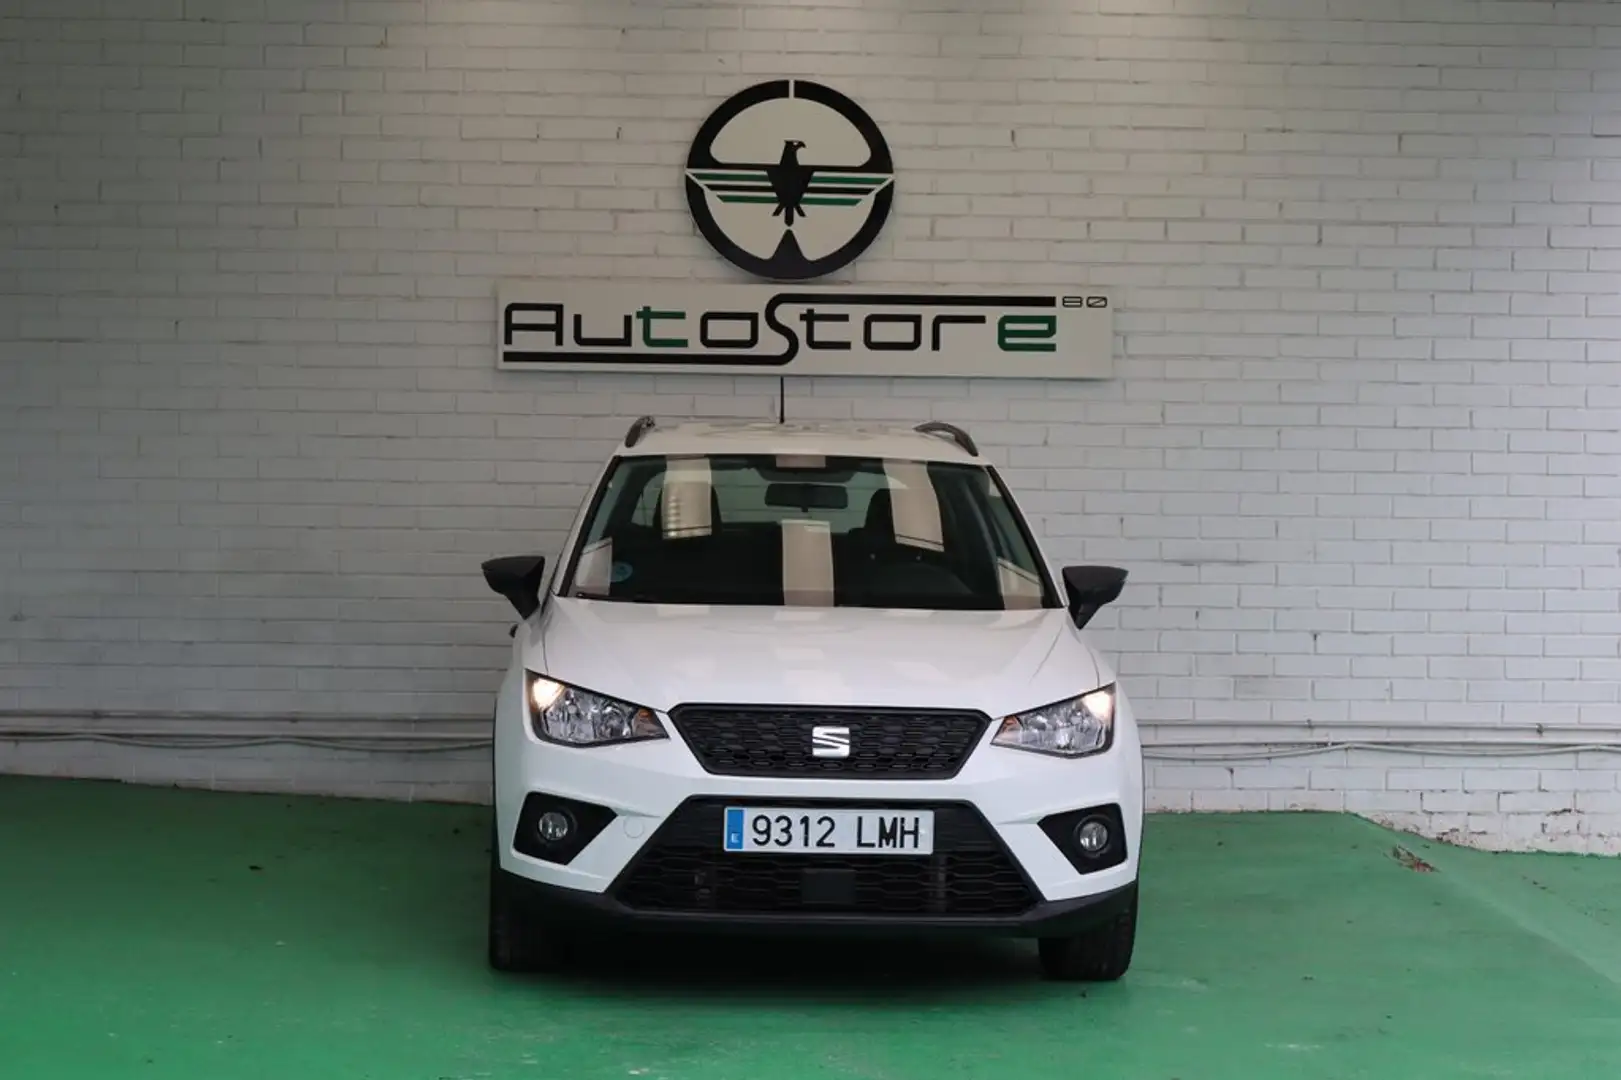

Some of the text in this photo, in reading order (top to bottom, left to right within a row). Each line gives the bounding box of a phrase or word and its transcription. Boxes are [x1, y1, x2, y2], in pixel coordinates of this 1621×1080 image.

[1062, 296, 1108, 308] 80
[752, 814, 835, 848] 9312
[857, 816, 920, 849] LMH
